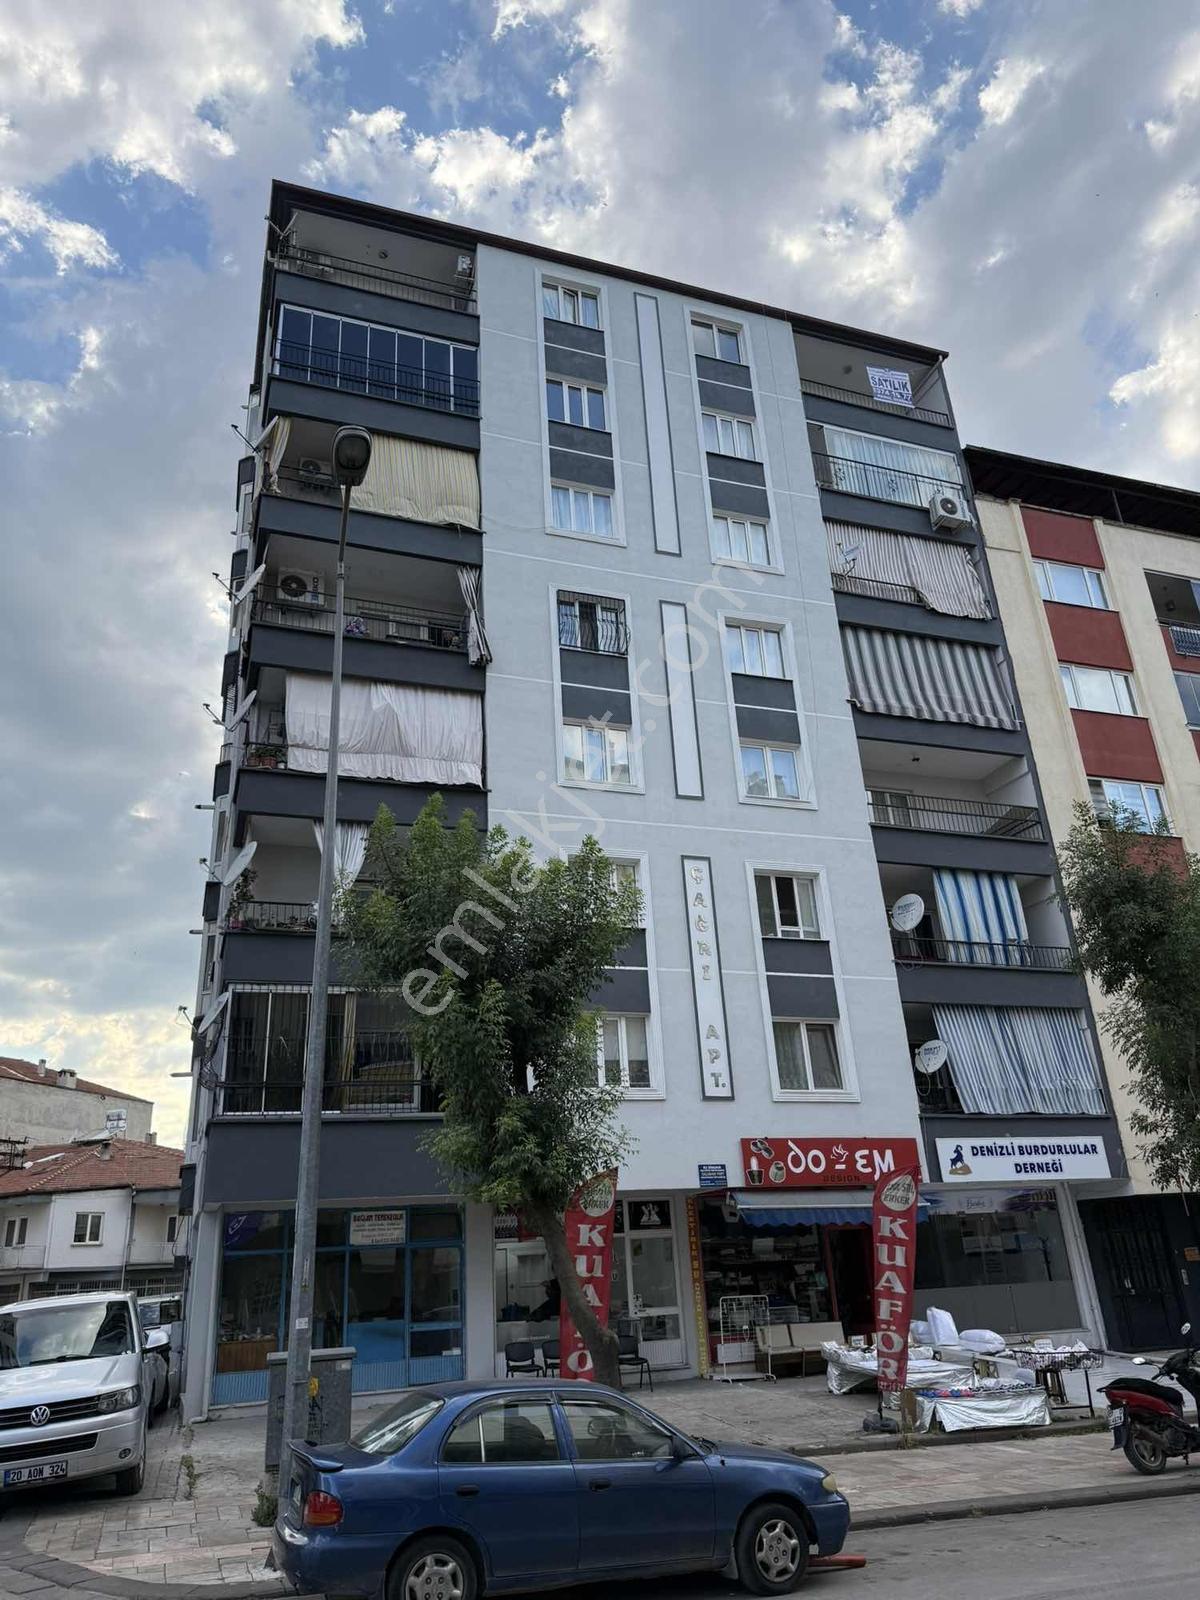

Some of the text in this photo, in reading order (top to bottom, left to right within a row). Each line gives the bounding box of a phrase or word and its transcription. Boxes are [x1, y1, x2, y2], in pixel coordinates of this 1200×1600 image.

[870, 376, 909, 392] SATILIK
[970, 1142, 1099, 1157] DENİZLİ BURDURLULAR
[1014, 1158, 1063, 1174] DERNEĞİ
[567, 1223, 608, 1382] KUAÖ
[874, 1215, 910, 1380] KUAFÖR
[11, 1471, 23, 1482] 20
[49, 1463, 65, 1475] 324
